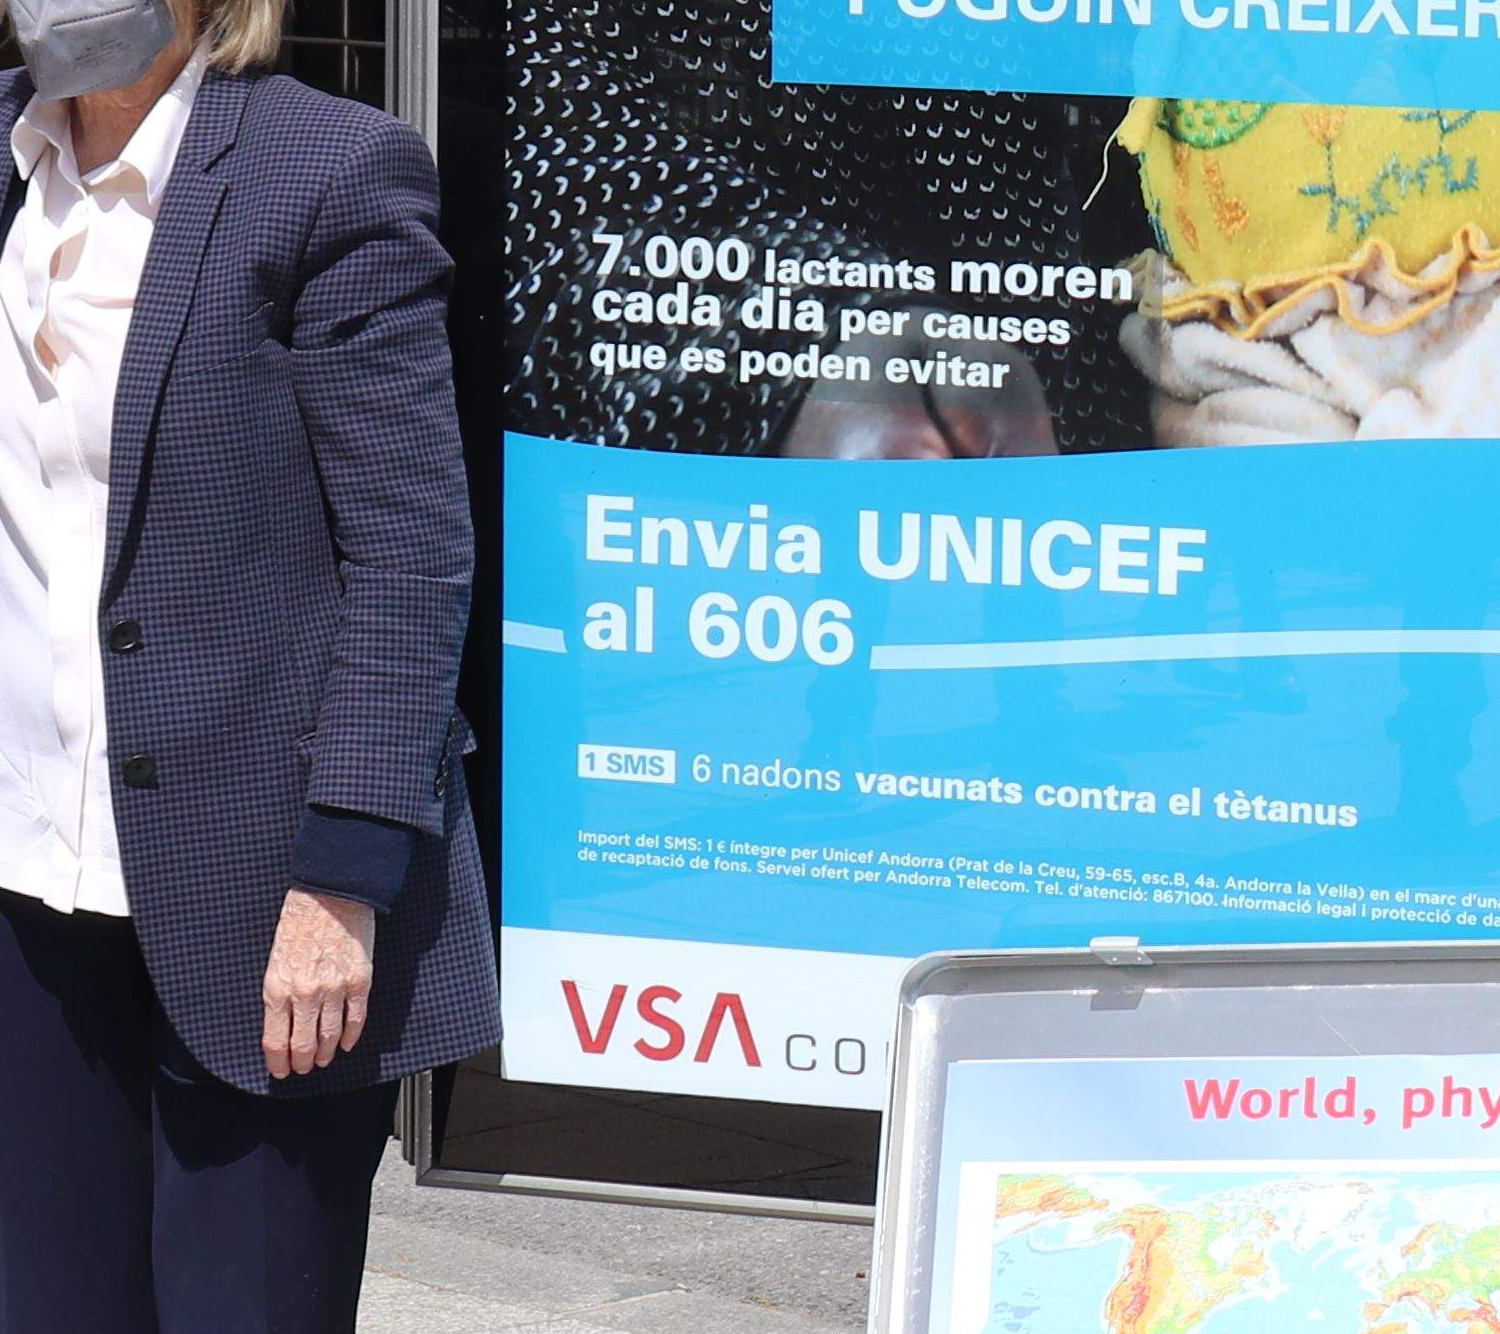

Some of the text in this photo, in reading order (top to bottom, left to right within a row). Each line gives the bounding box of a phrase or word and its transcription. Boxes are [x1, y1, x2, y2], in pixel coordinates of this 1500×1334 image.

[591, 233, 1134, 301] 7.000 lactants moren
[591, 283, 1071, 346] cada dia per causes
[589, 337, 1010, 388] que es poden evitar
[585, 493, 1207, 596] Envia UNICEF
[583, 587, 855, 666] al 606
[584, 752, 666, 778] 1 SMS
[691, 754, 1359, 828] 6 nadons vacunats contra el tètanus
[577, 847, 598, 862] de
[602, 850, 685, 869] recaptació
[690, 854, 710, 871] de
[714, 856, 752, 874] fons.
[756, 861, 806, 877] Servei
[811, 864, 850, 881] ofert
[854, 869, 880, 884] per
[885, 870, 952, 889] Andorra
[956, 874, 1031, 894] Telecom.
[1035, 880, 1064, 896] Tel.
[1222, 894, 1312, 915] Informació
[1316, 901, 1357, 919] legal
[1371, 906, 1452, 924] protecció
[1456, 910, 1478, 926] de
[578, 829, 630, 848] Import
[636, 833, 660, 849] del
[664, 835, 702, 851] SMS:
[791, 847, 818, 863] per
[822, 848, 874, 865] Unicef
[877, 851, 944, 870] Andorra
[948, 856, 989, 874] (Prat
[993, 858, 1015, 874] de
[1018, 860, 1033, 876] la
[1037, 862, 1080, 881] Creu,
[1224, 876, 1292, 895] Andorra
[1297, 879, 1312, 896] la
[1316, 882, 1366, 901] Vella)
[1369, 889, 1390, 902] en
[1395, 888, 1410, 903] el
[1414, 890, 1457, 907] marc
[1183, 1074, 1378, 1130] World,
